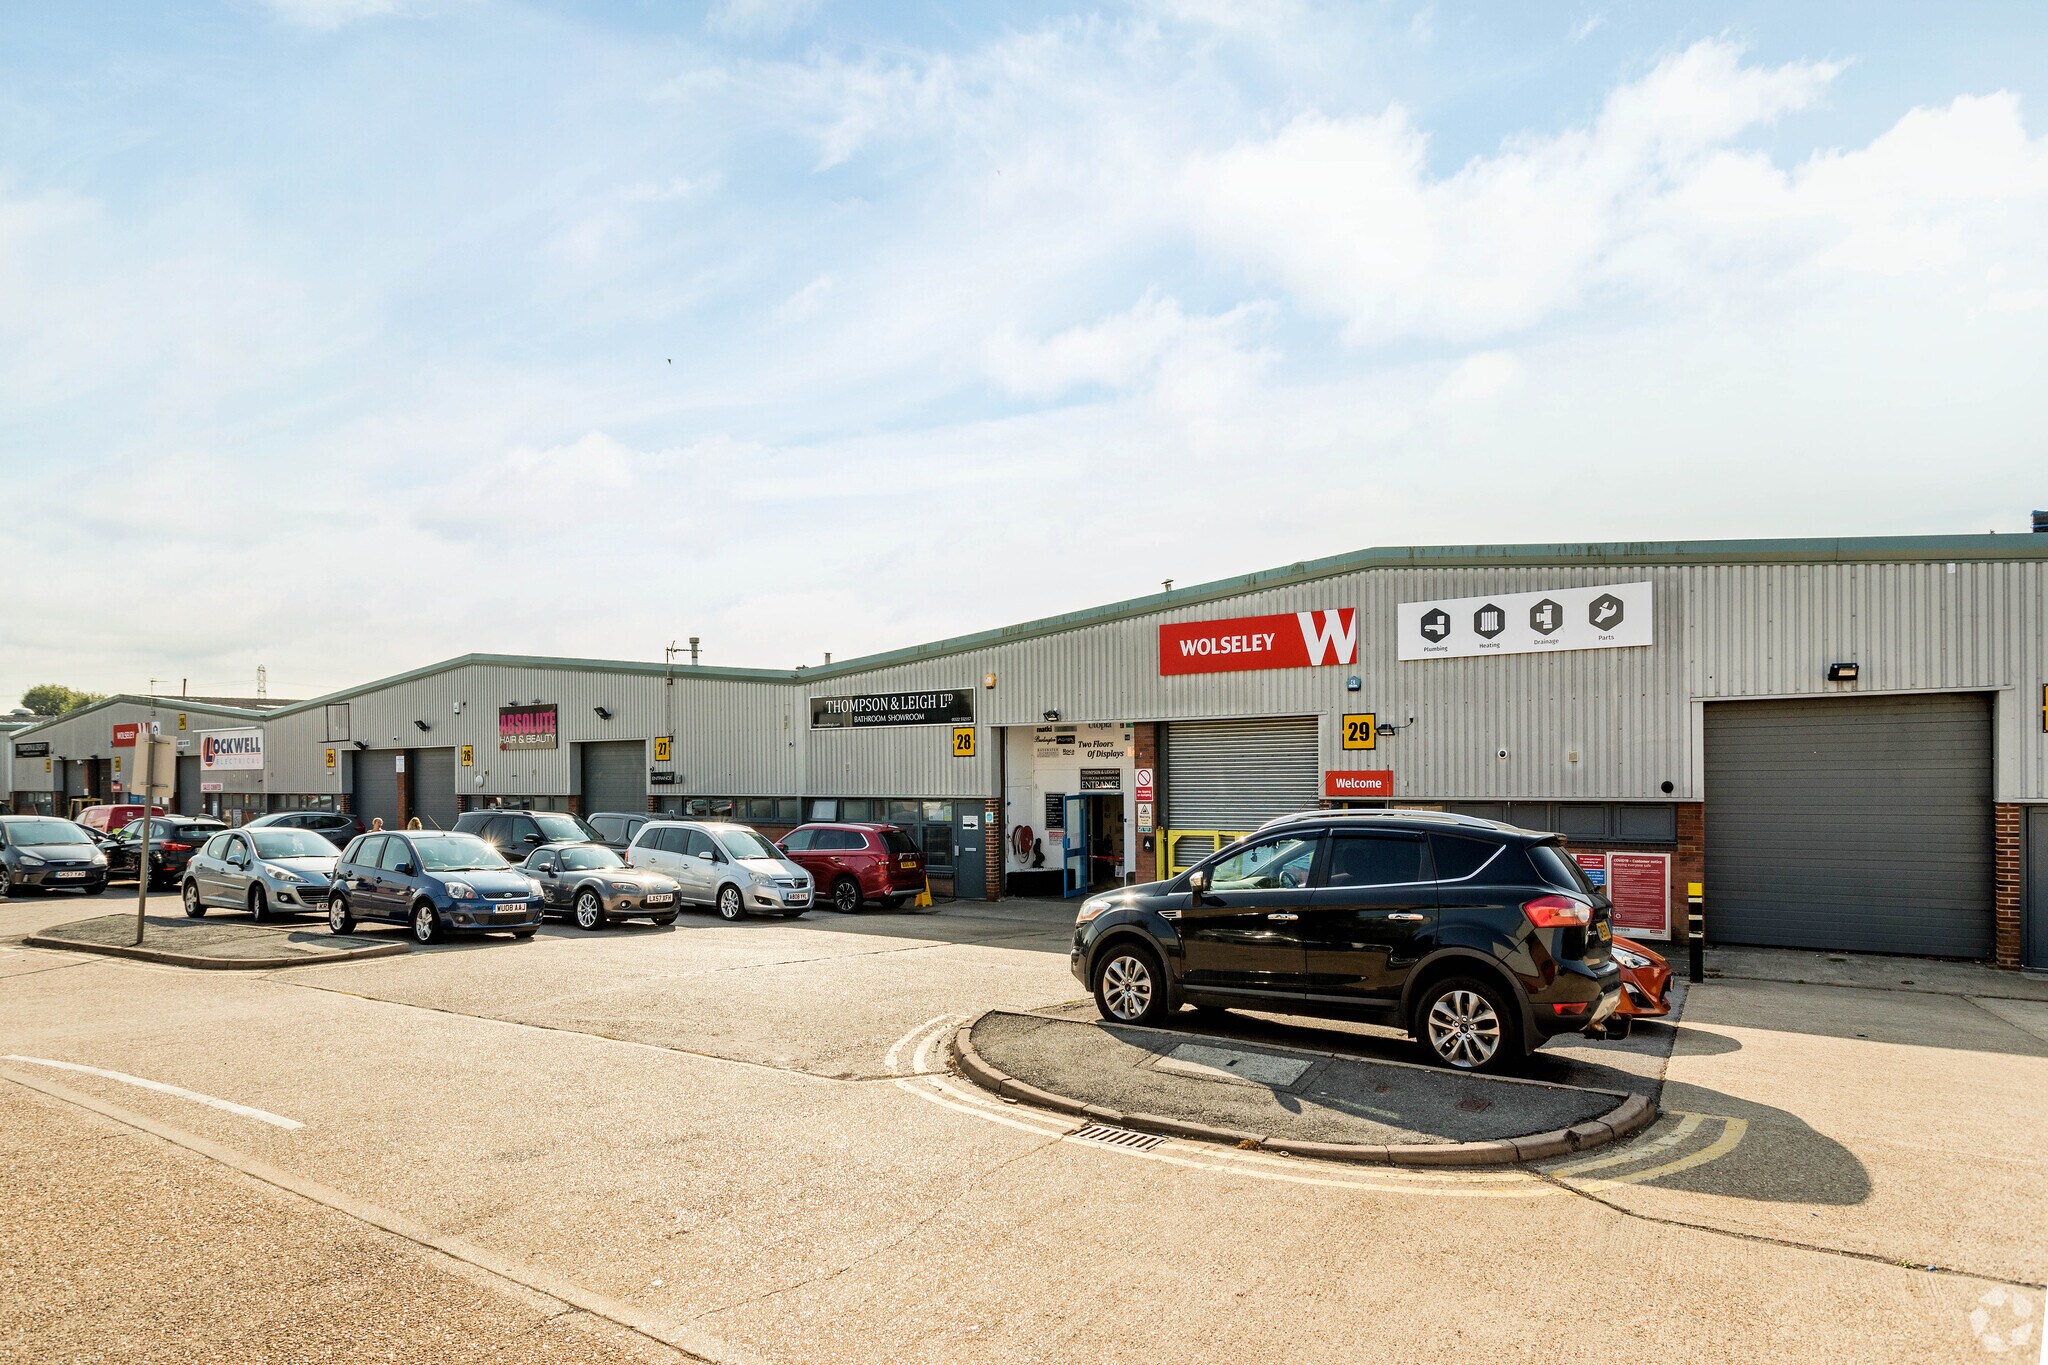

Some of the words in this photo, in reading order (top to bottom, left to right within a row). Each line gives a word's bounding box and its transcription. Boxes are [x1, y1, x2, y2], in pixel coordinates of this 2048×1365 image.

[1179, 633, 1275, 657] WOLSELEY
[1296, 608, 1356, 667] W
[1533, 637, 1560, 645] Drainage
[1423, 645, 1448, 653] Plumbing
[826, 697, 889, 714] THOMPSON
[890, 696, 899, 710] &
[901, 694, 936, 710] LEIGH
[500, 711, 556, 735] ABSOLUTE
[853, 714, 887, 723] BATHROOM
[887, 713, 925, 722] SHOWROOM
[1348, 722, 1370, 742] 29
[500, 735, 517, 743] HAIR
[518, 735, 525, 744] &
[526, 734, 556, 743] BEAUTY
[957, 734, 971, 750] 28
[1093, 740, 1114, 748] Floors
[205, 737, 261, 762] LOCKWELL
[658, 742, 667, 755] 27
[327, 753, 334, 763] 25
[463, 750, 471, 762] 26
[1087, 750, 1096, 759] Of
[1096, 750, 1124, 759] Displays
[1081, 780, 1120, 789] ENTRANCE
[1335, 778, 1382, 788] Welcome
